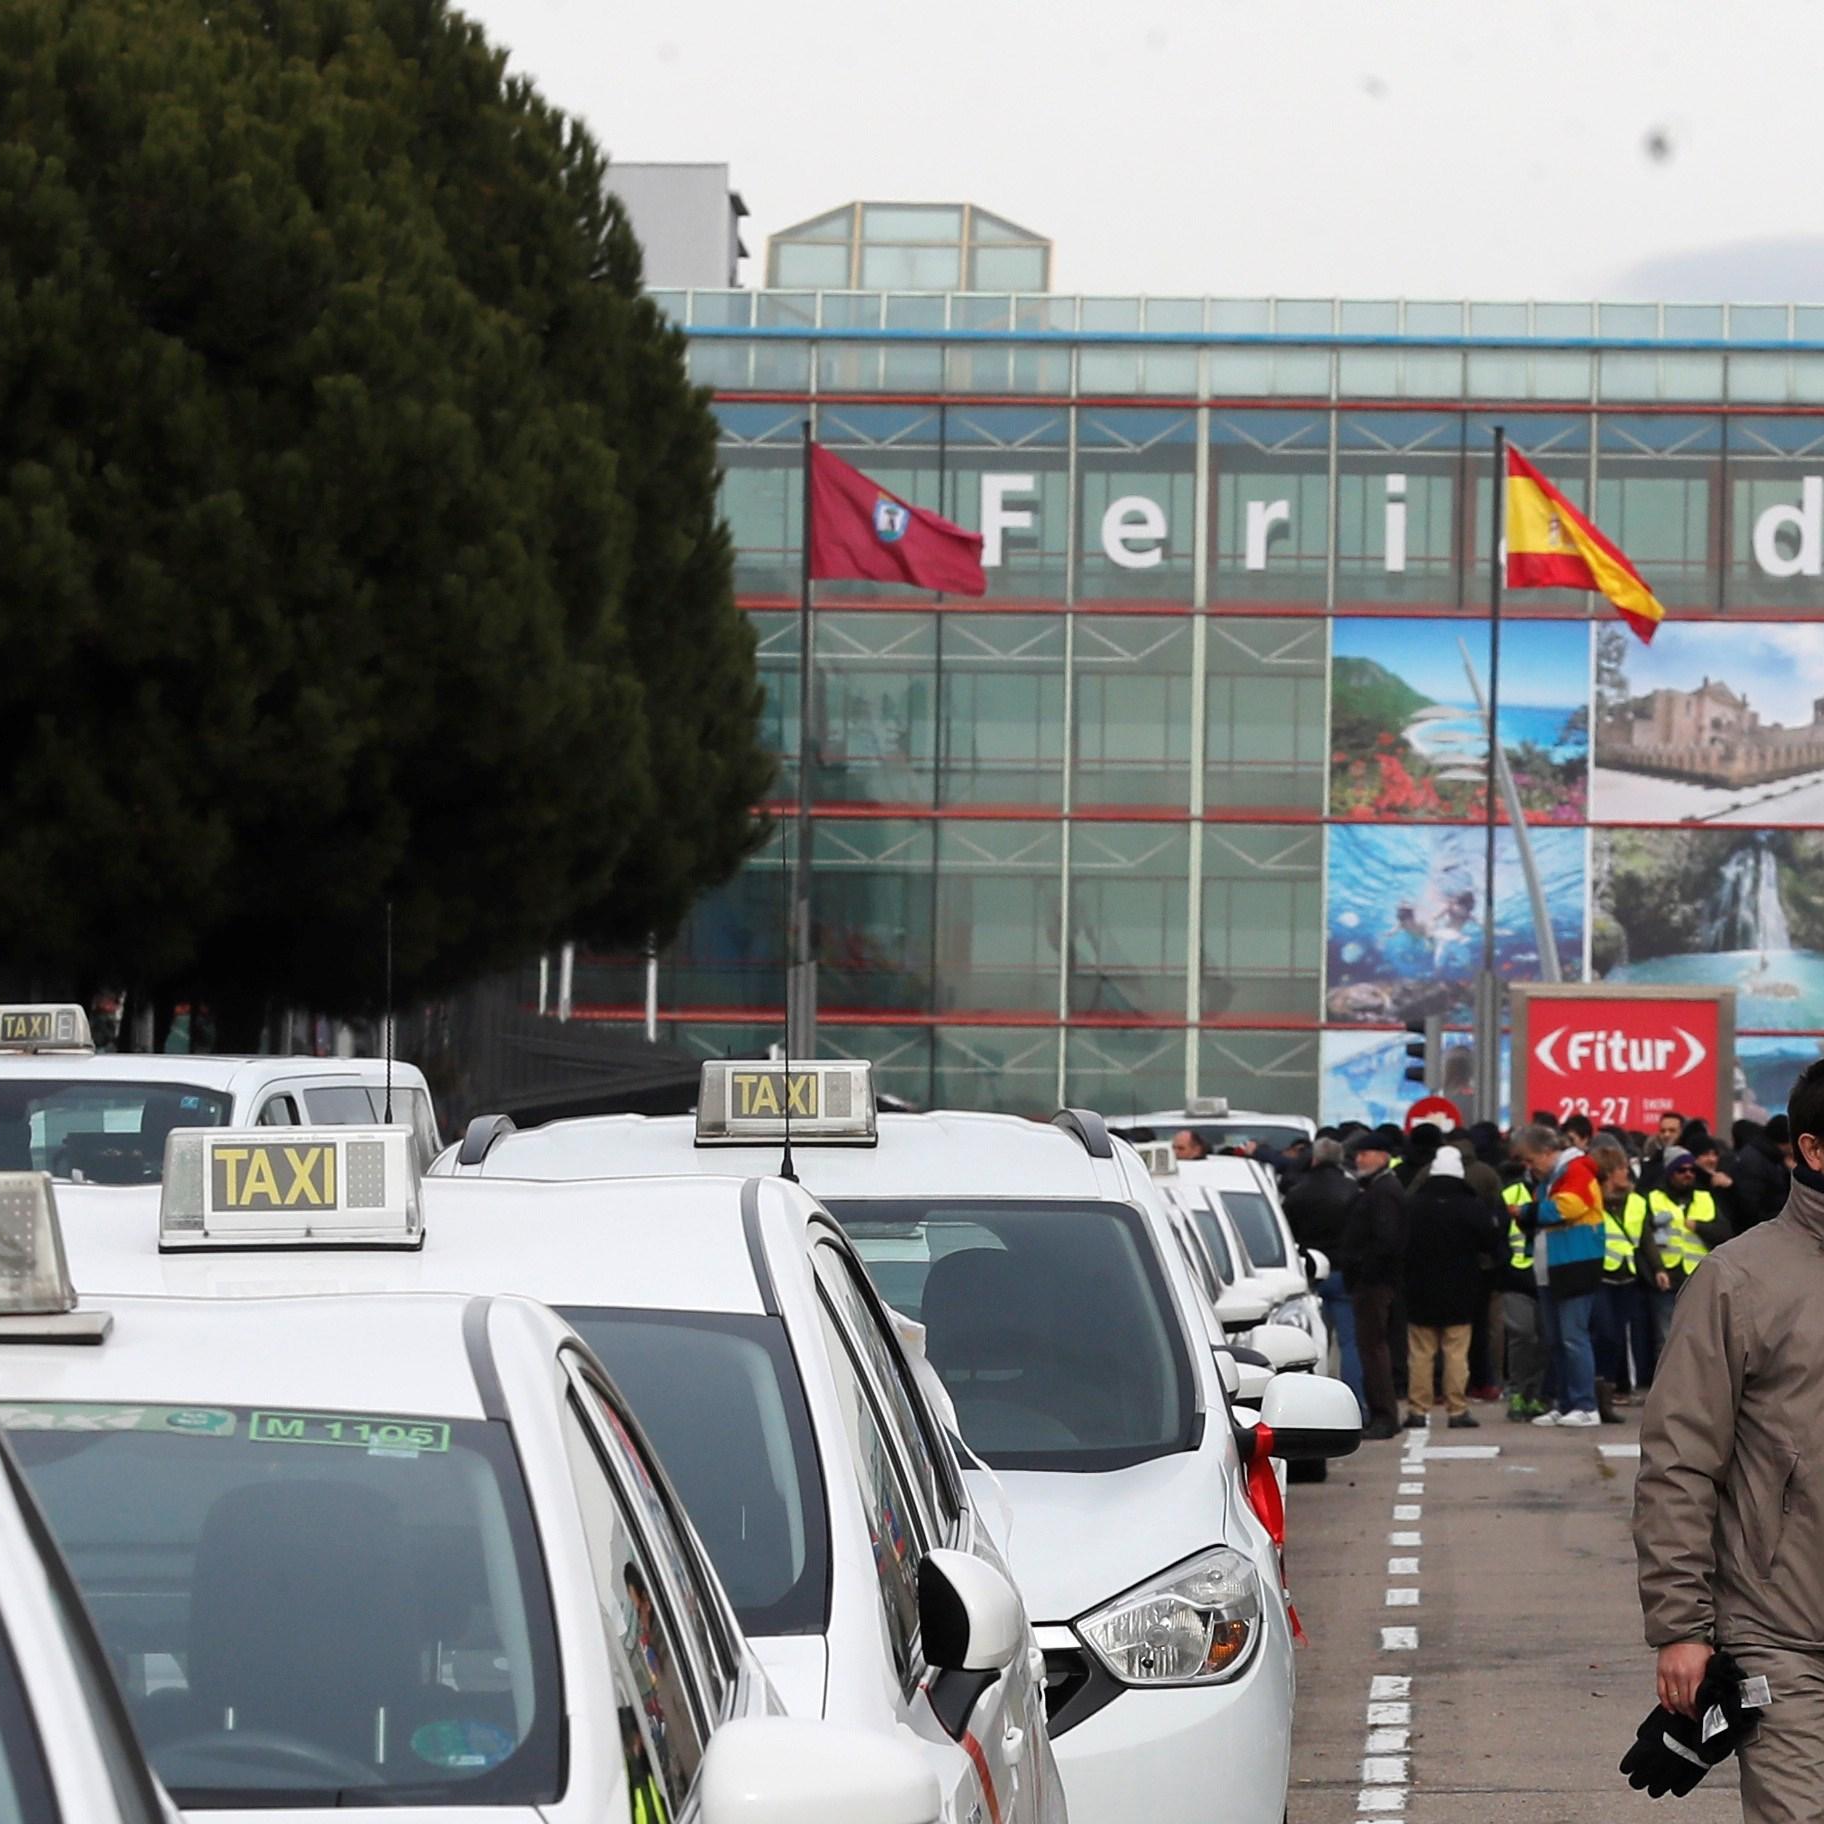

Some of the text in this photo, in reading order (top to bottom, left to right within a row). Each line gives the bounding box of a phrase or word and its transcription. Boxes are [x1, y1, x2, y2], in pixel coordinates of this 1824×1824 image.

[980, 473, 1508, 571] Feri
[3, 1015, 51, 1039] TAXI
[1566, 1029, 1677, 1073] Fitur
[733, 1075, 817, 1116] TAXI
[213, 1147, 335, 1206] TAXI
[266, 1417, 435, 1445] M 1105
